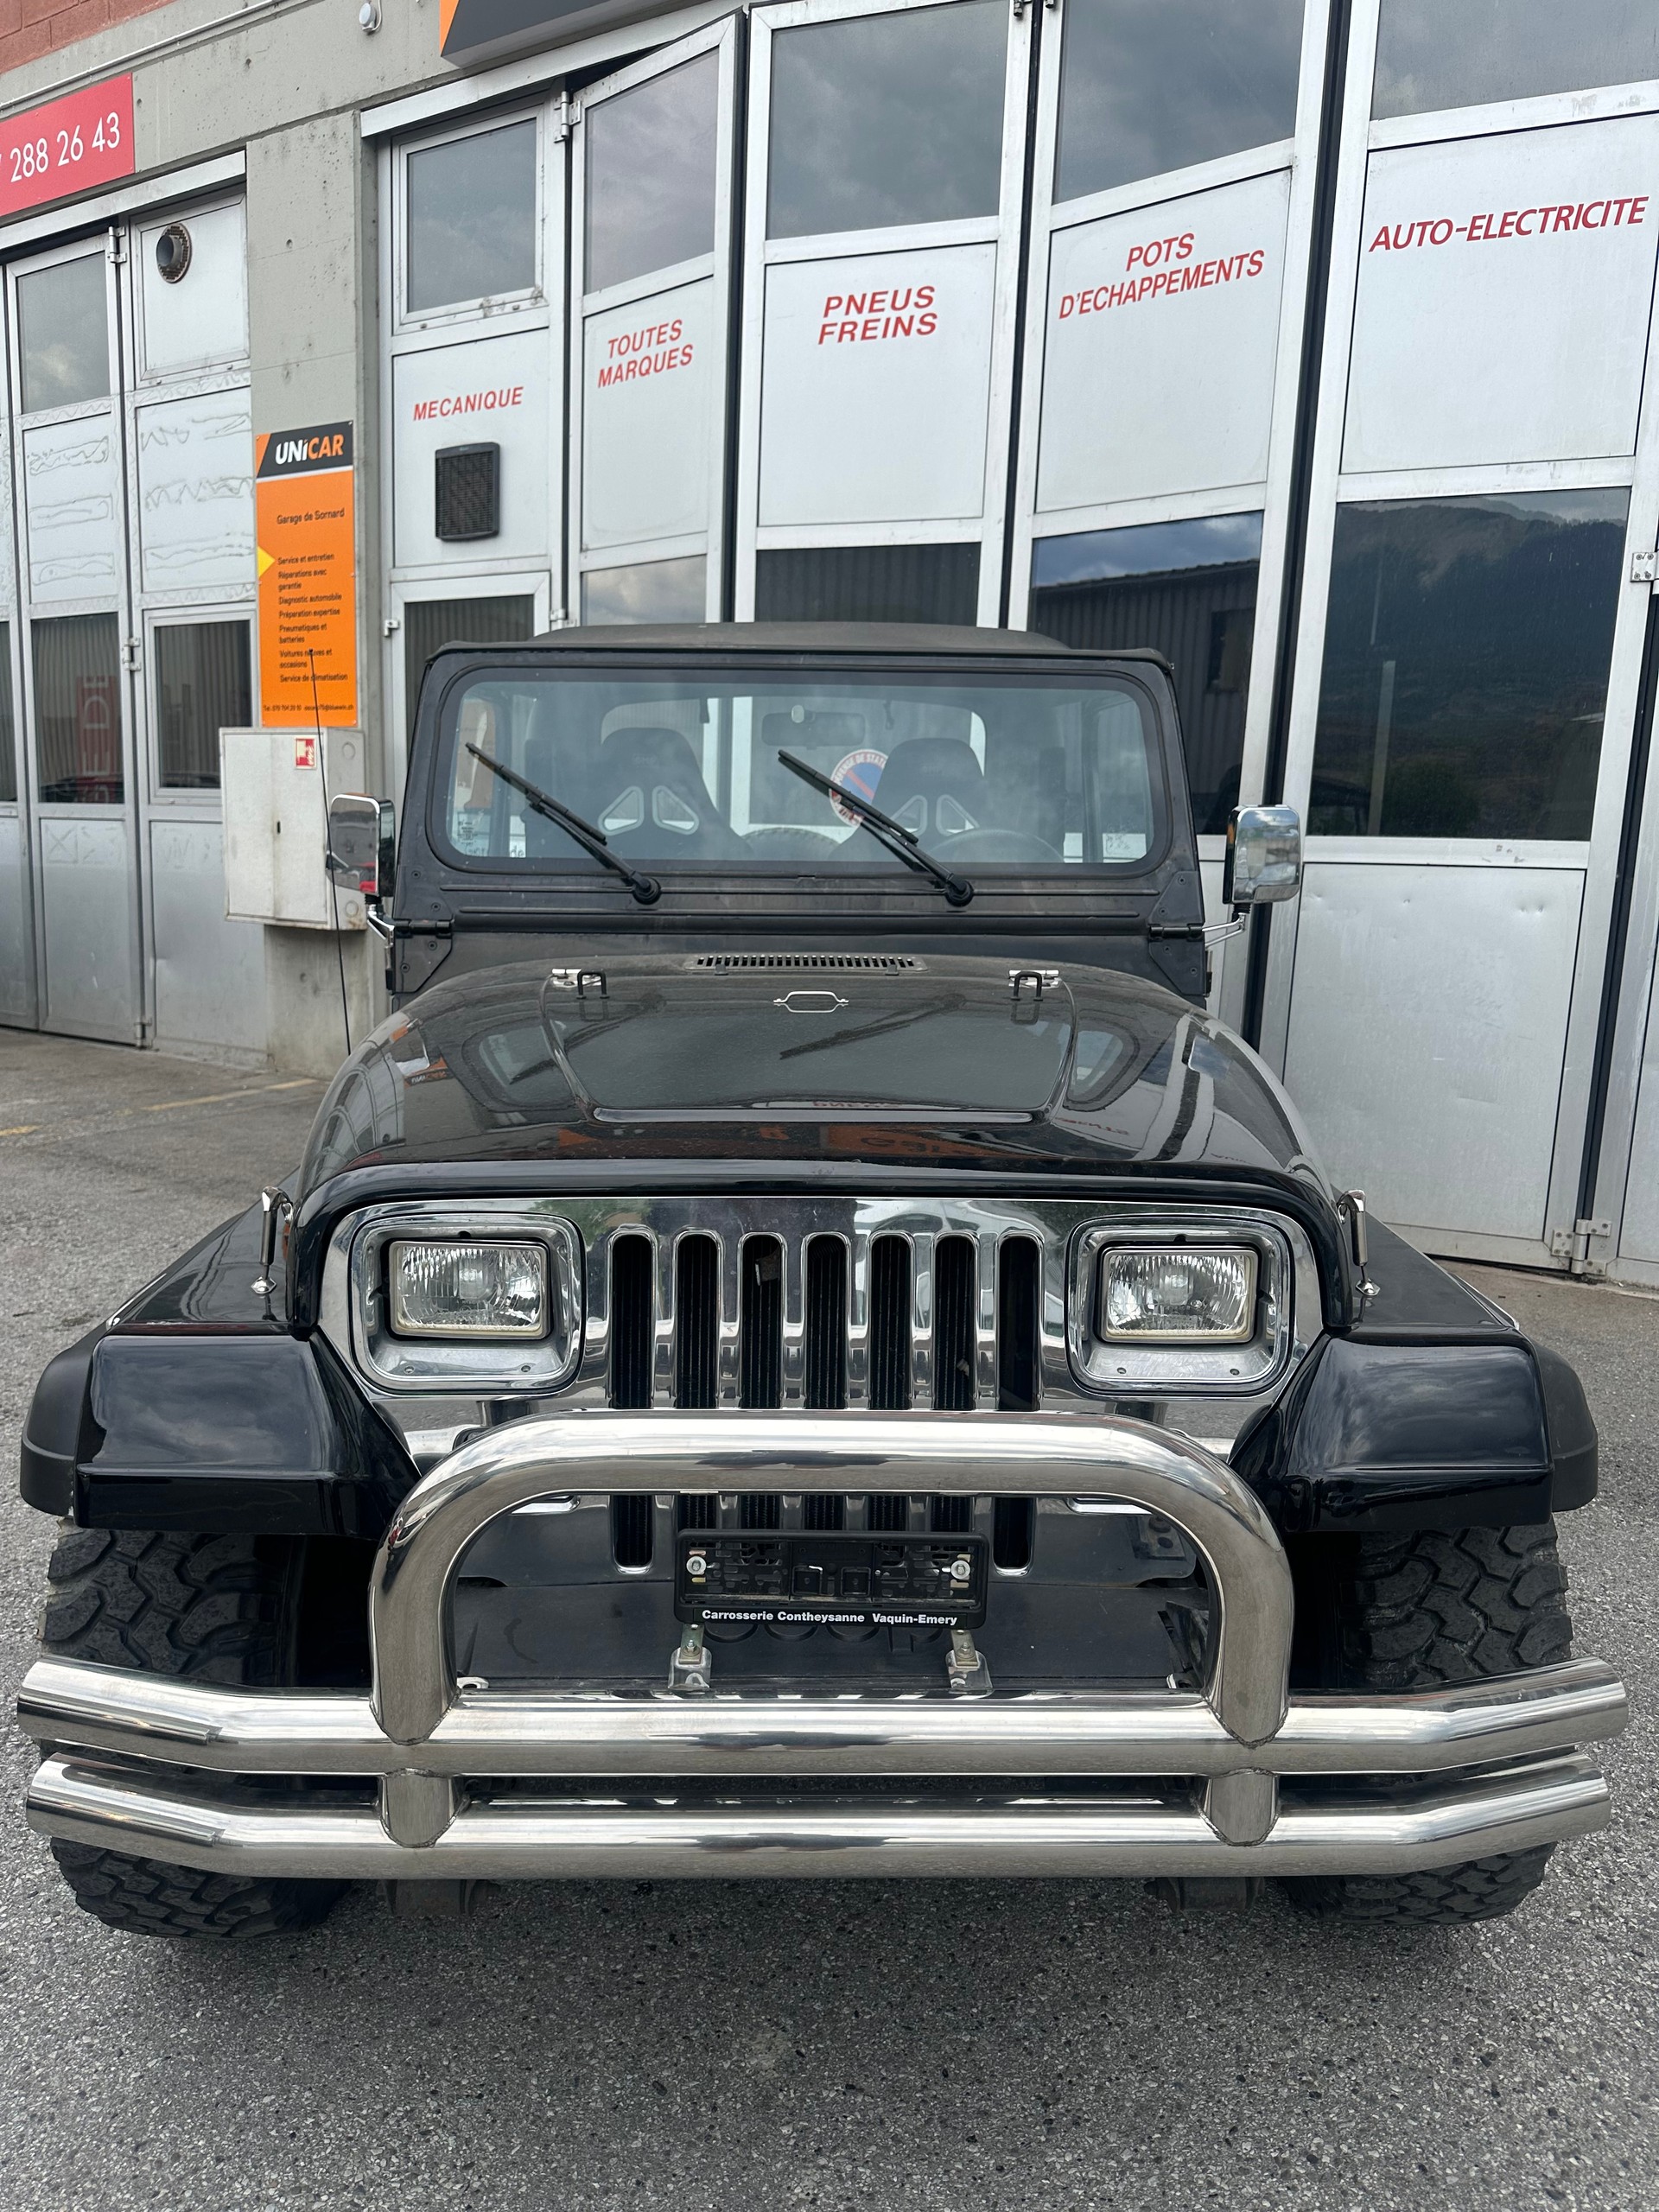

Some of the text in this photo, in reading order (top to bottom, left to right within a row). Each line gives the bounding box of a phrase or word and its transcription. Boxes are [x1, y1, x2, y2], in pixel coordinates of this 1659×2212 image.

[10, 111, 120, 182] 288 26 43
[1368, 196, 1649, 253] AUTO-ELECTRICITE
[1126, 232, 1195, 272] POTS
[1058, 250, 1265, 320] D'ECHAPPEMENTS
[823, 285, 935, 318] PNEUS
[817, 312, 938, 346] FREINS
[607, 319, 683, 359] TOUTES
[597, 344, 694, 389] MARQUES
[413, 386, 524, 422] MECANIQUE
[276, 507, 346, 524] Garage de Sornard
[277, 552, 335, 565] Service et entretien
[313, 568, 327, 577] avec
[278, 581, 302, 593] garantie
[278, 592, 343, 606] Diagnostic automobile
[313, 607, 341, 618] expertise
[279, 622, 327, 634] Pneumatiques et
[278, 635, 305, 645] batteries
[279, 649, 303, 658] Voitures
[326, 647, 333, 656] et
[279, 660, 308, 669] occasions
[279, 674, 301, 683] Service
[302, 673, 309, 682] de
[702, 1609, 958, 1626] Carrosserie Contheysanne Vaquin-Emery
